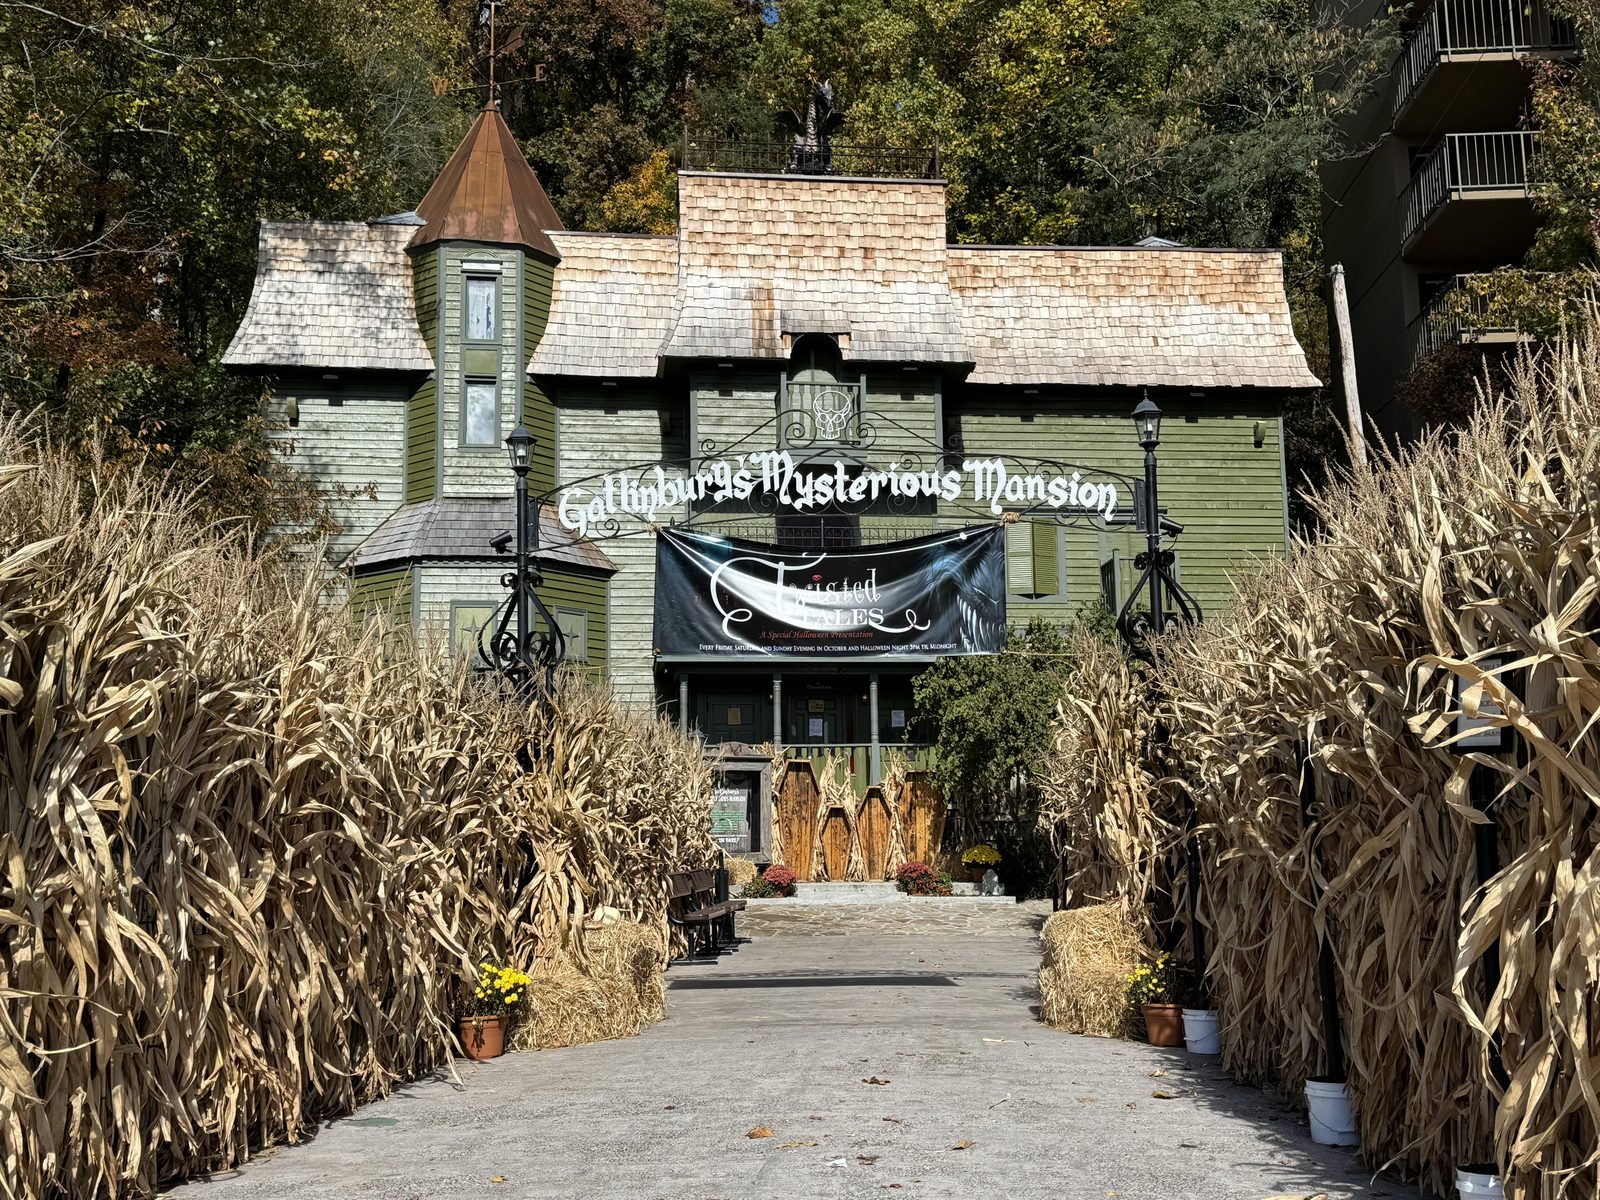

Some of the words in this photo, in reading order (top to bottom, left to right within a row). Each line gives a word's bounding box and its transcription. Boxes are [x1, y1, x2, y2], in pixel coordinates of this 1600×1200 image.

[535, 63, 547, 82] E
[431, 78, 449, 96] W
[558, 456, 752, 537] Gatlinburg's
[749, 449, 962, 511] Mysterious
[962, 457, 1117, 521] Mansion
[710, 552, 881, 630] Twisted
[760, 630, 766, 638] A
[767, 630, 791, 640] Special
[793, 630, 829, 639] Halloween
[830, 630, 874, 639] Presentation
[860, 644, 890, 652] HALLOWEEN
